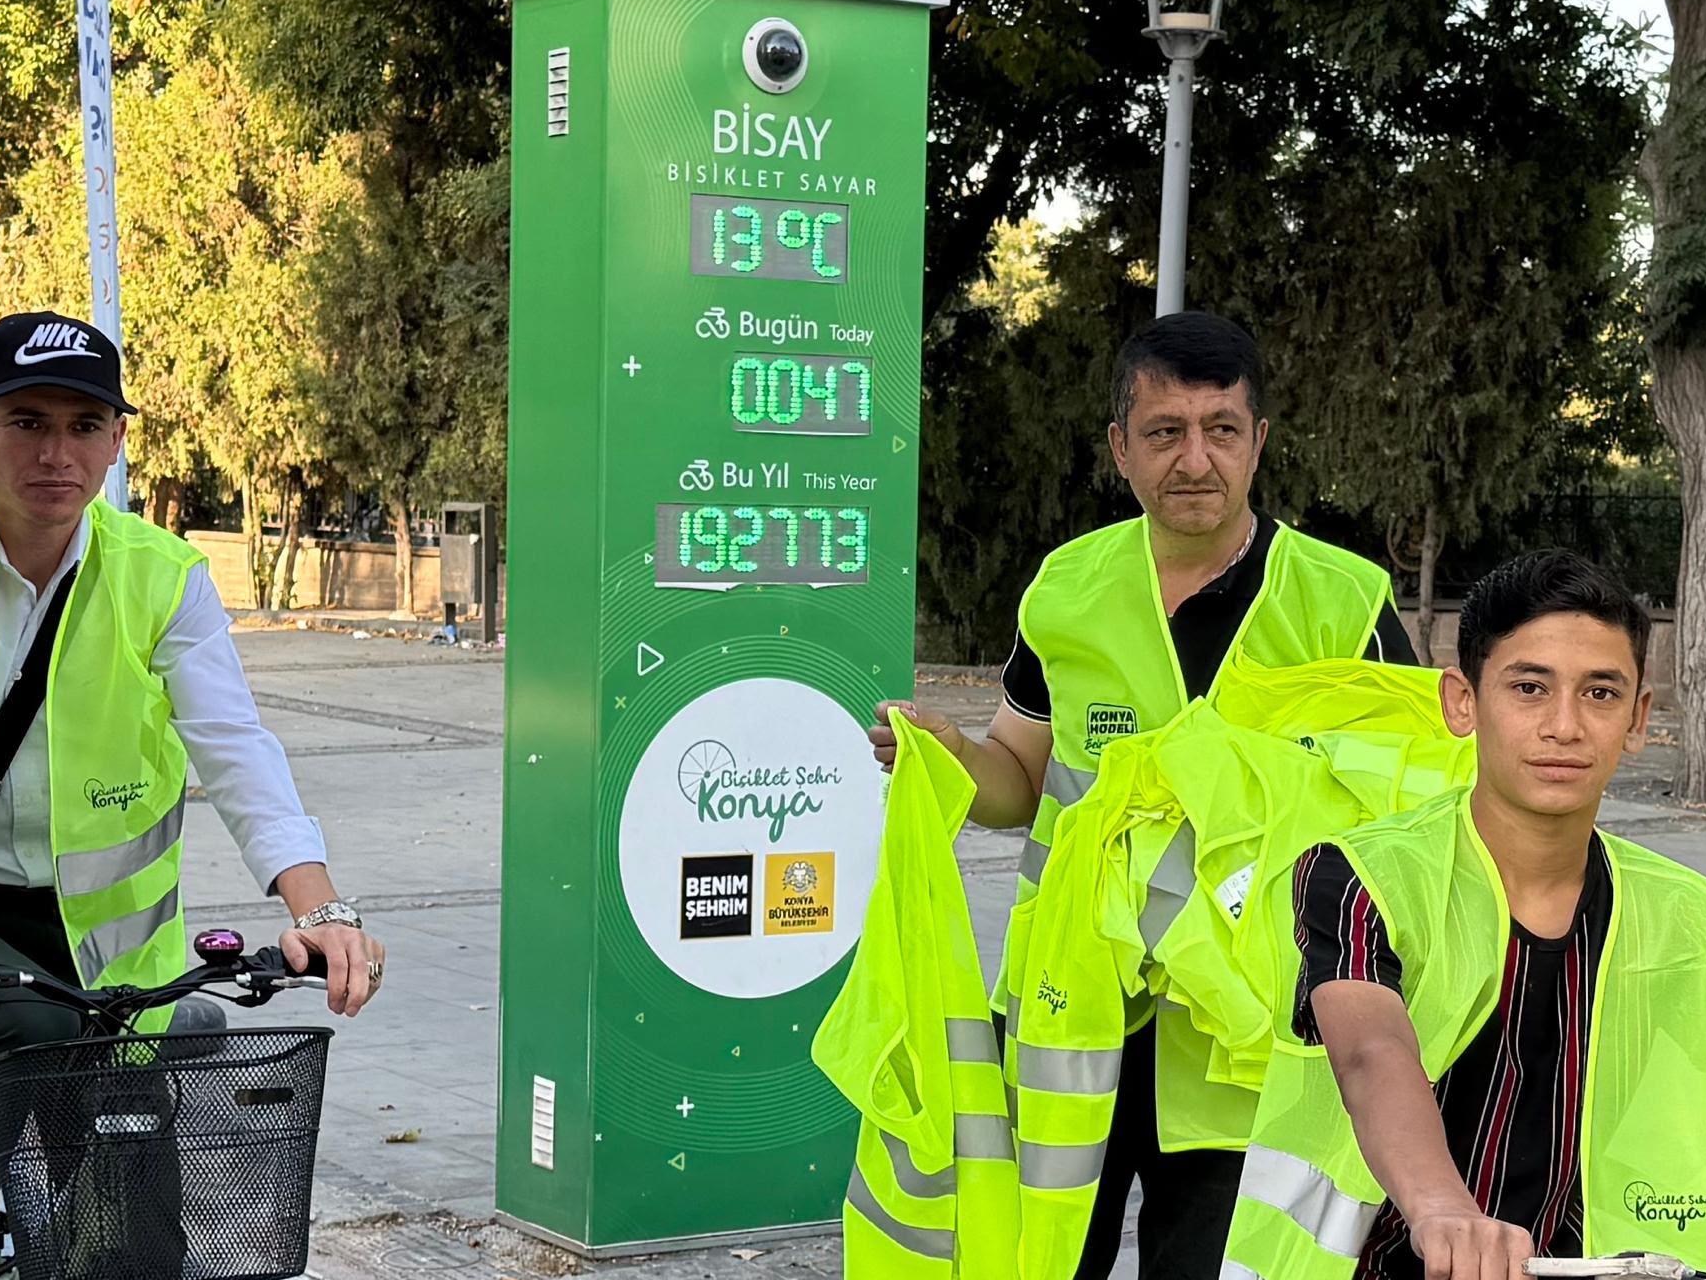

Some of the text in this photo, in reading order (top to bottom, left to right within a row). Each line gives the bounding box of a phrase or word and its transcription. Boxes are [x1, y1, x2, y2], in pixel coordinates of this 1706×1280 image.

[713, 102, 833, 161] BİSAY
[667, 161, 876, 196] BİSİKLET SAYAR
[713, 205, 762, 272] 13
[26, 323, 90, 351] NIKE
[739, 311, 874, 347] Bugün Today
[731, 357, 871, 424] 0047
[722, 462, 877, 491] Bu Yıl This Year
[679, 506, 868, 573] 192773
[1090, 710, 1134, 722] KONYA
[721, 765, 843, 789] Bisiklet Şehri
[91, 789, 143, 811] Konya
[697, 777, 824, 843] Konya
[685, 897, 748, 920] ŞEHRİM
[784, 896, 815, 906] KONYA
[1636, 1197, 1706, 1231] Konya
